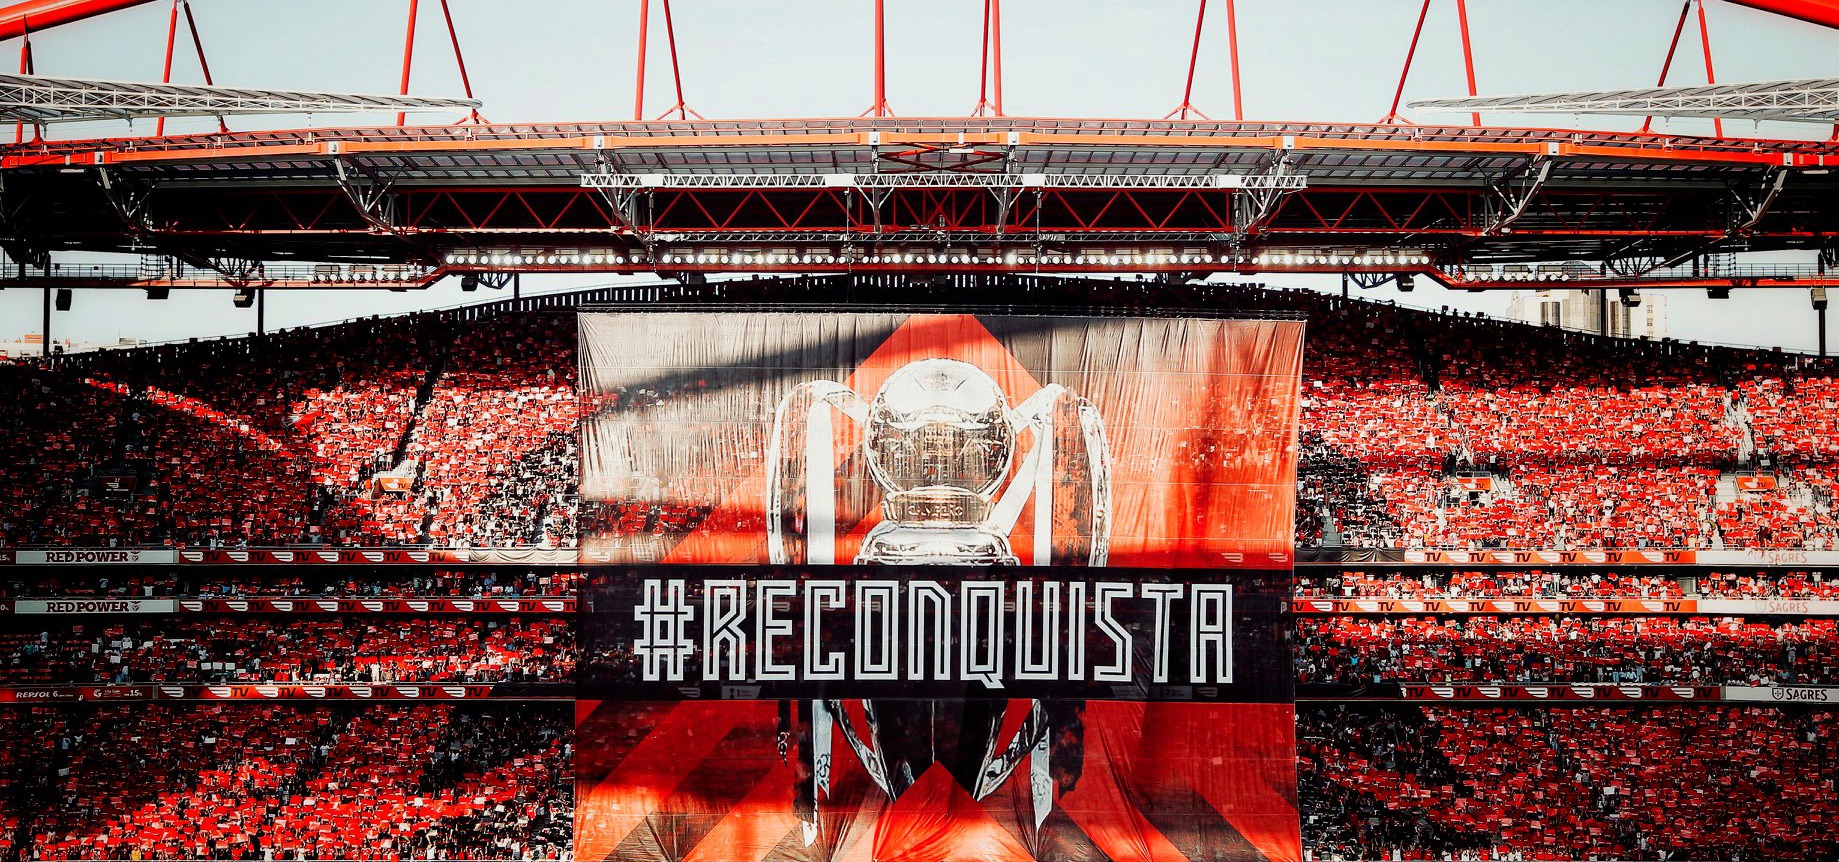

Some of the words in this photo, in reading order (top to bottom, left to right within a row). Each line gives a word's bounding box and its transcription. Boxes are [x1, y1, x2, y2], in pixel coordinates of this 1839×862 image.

[46, 551, 74, 562] RED
[76, 551, 128, 562] POWER
[1768, 552, 1807, 563] SAGRES
[46, 602, 75, 612] RED
[77, 602, 129, 612] POWER
[1769, 601, 1808, 613] SAGRES
[634, 579, 1233, 688] #RECONQUISTA
[1786, 688, 1828, 701] SAGRES
